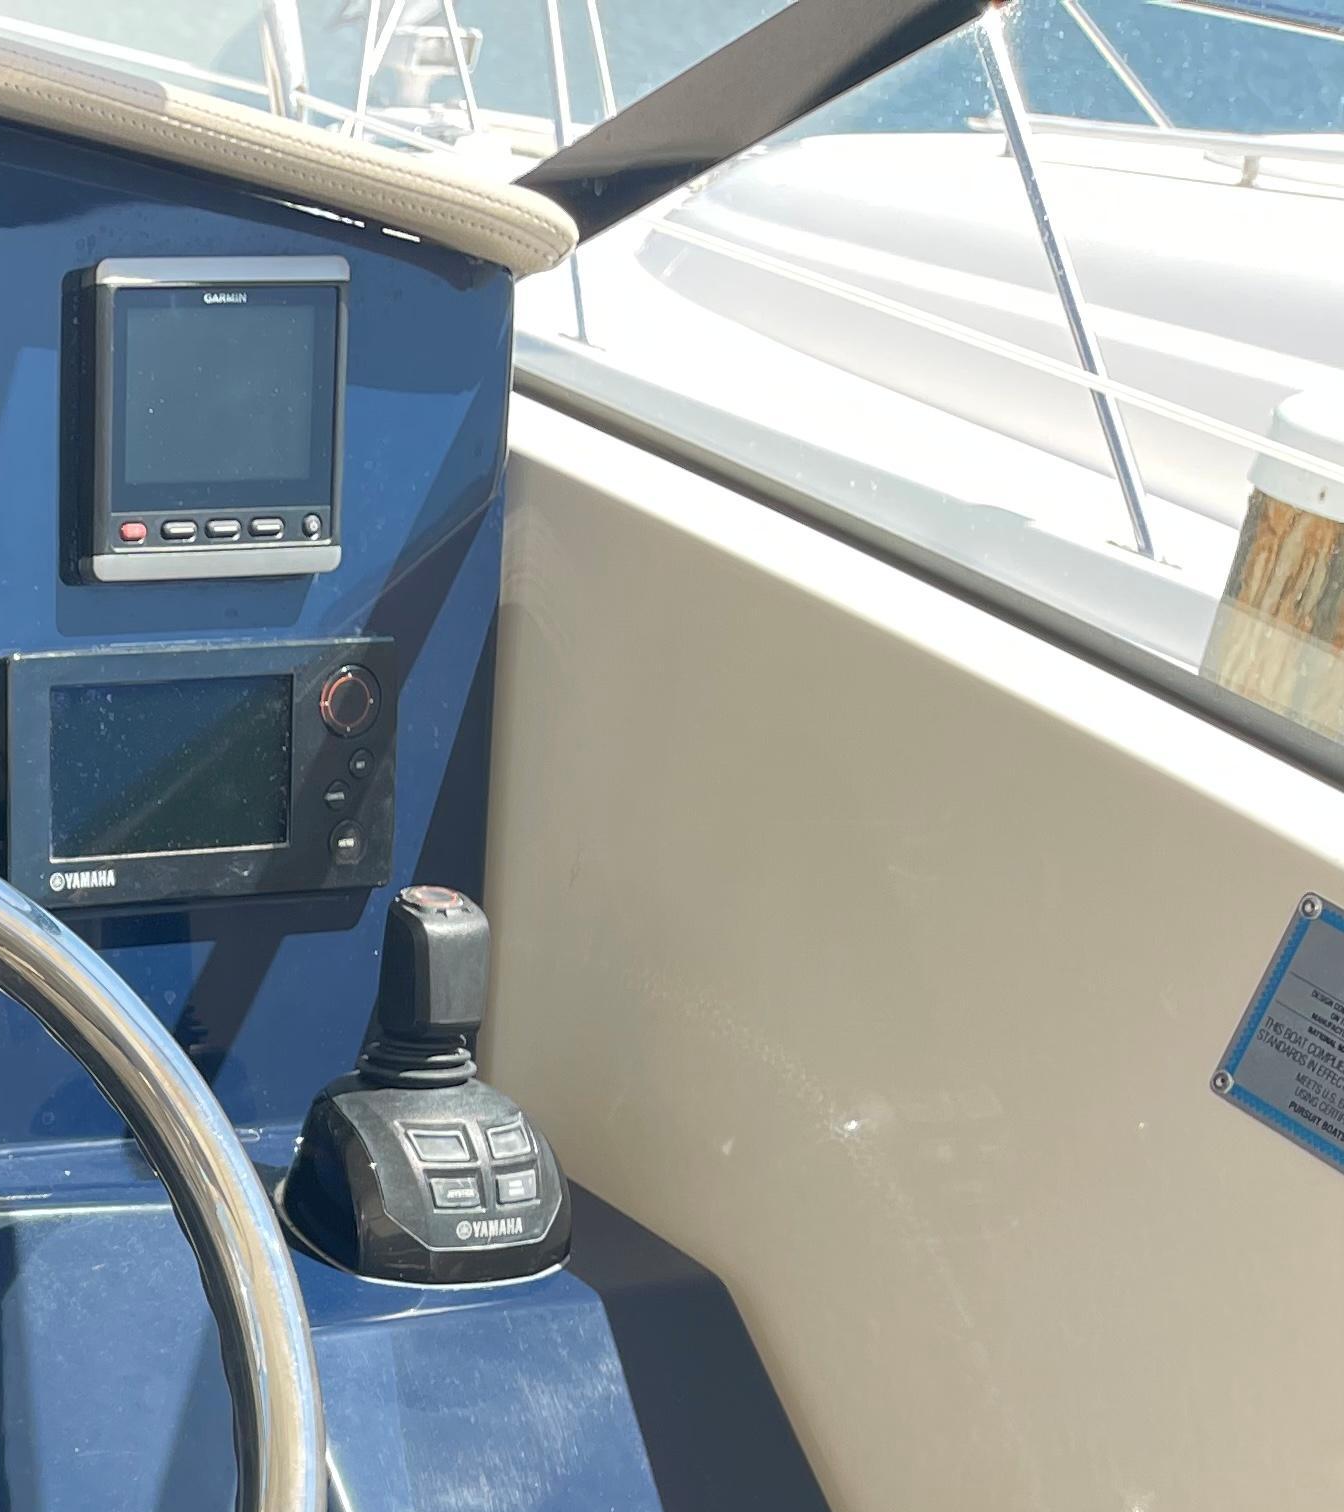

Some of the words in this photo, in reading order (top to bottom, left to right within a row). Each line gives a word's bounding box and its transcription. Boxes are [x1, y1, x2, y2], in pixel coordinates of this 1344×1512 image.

[203, 292, 247, 304] GARMIN
[65, 870, 115, 889] YAMAHA
[1265, 1015, 1283, 1035] THIS
[1283, 1026, 1308, 1049] BOAT
[1257, 1028, 1306, 1067] STANDARDS
[1307, 1058, 1317, 1073] IN
[1296, 1072, 1321, 1097] MEETS
[1294, 1086, 1318, 1109] USING
[1289, 1101, 1322, 1126] PURSUIT
[472, 1217, 523, 1238] YAMAHA
